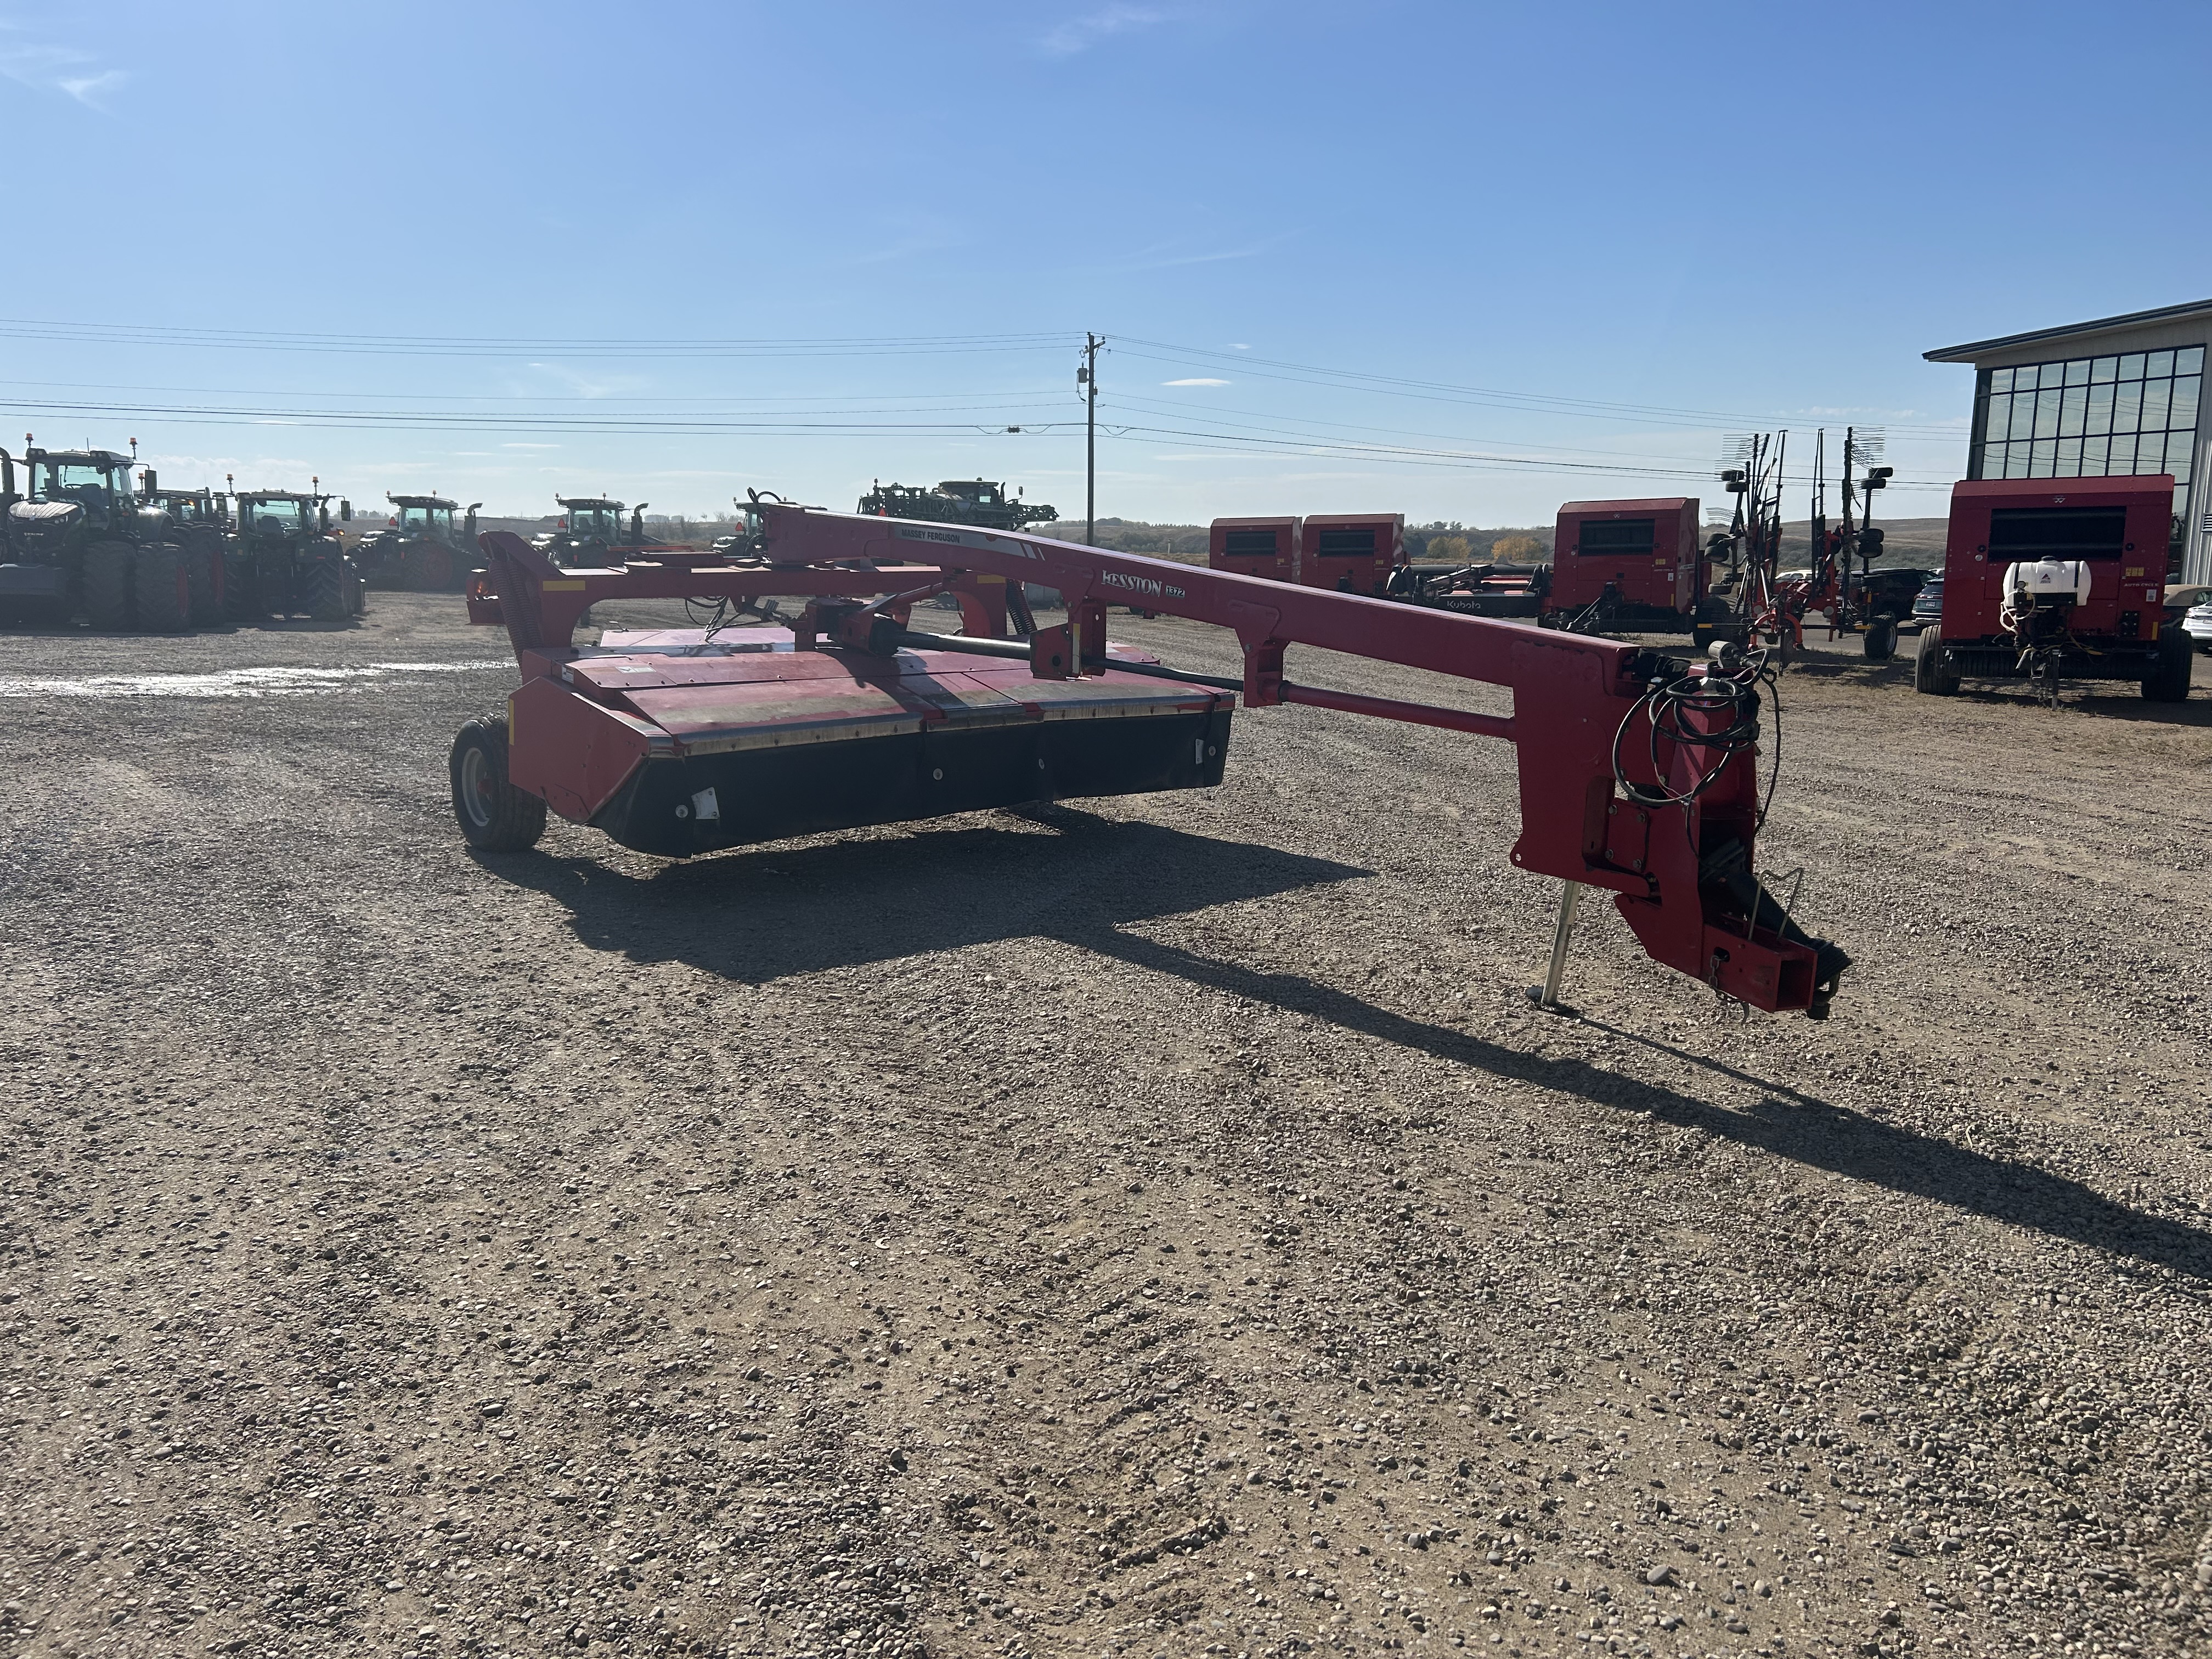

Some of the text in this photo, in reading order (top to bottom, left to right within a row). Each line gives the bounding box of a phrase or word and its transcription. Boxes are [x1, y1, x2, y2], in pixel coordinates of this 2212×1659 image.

[901, 529, 960, 543] MASSEY FERGUSON
[1101, 569, 1184, 597] HESSTON 1372
[1447, 600, 1481, 609] Kubota
